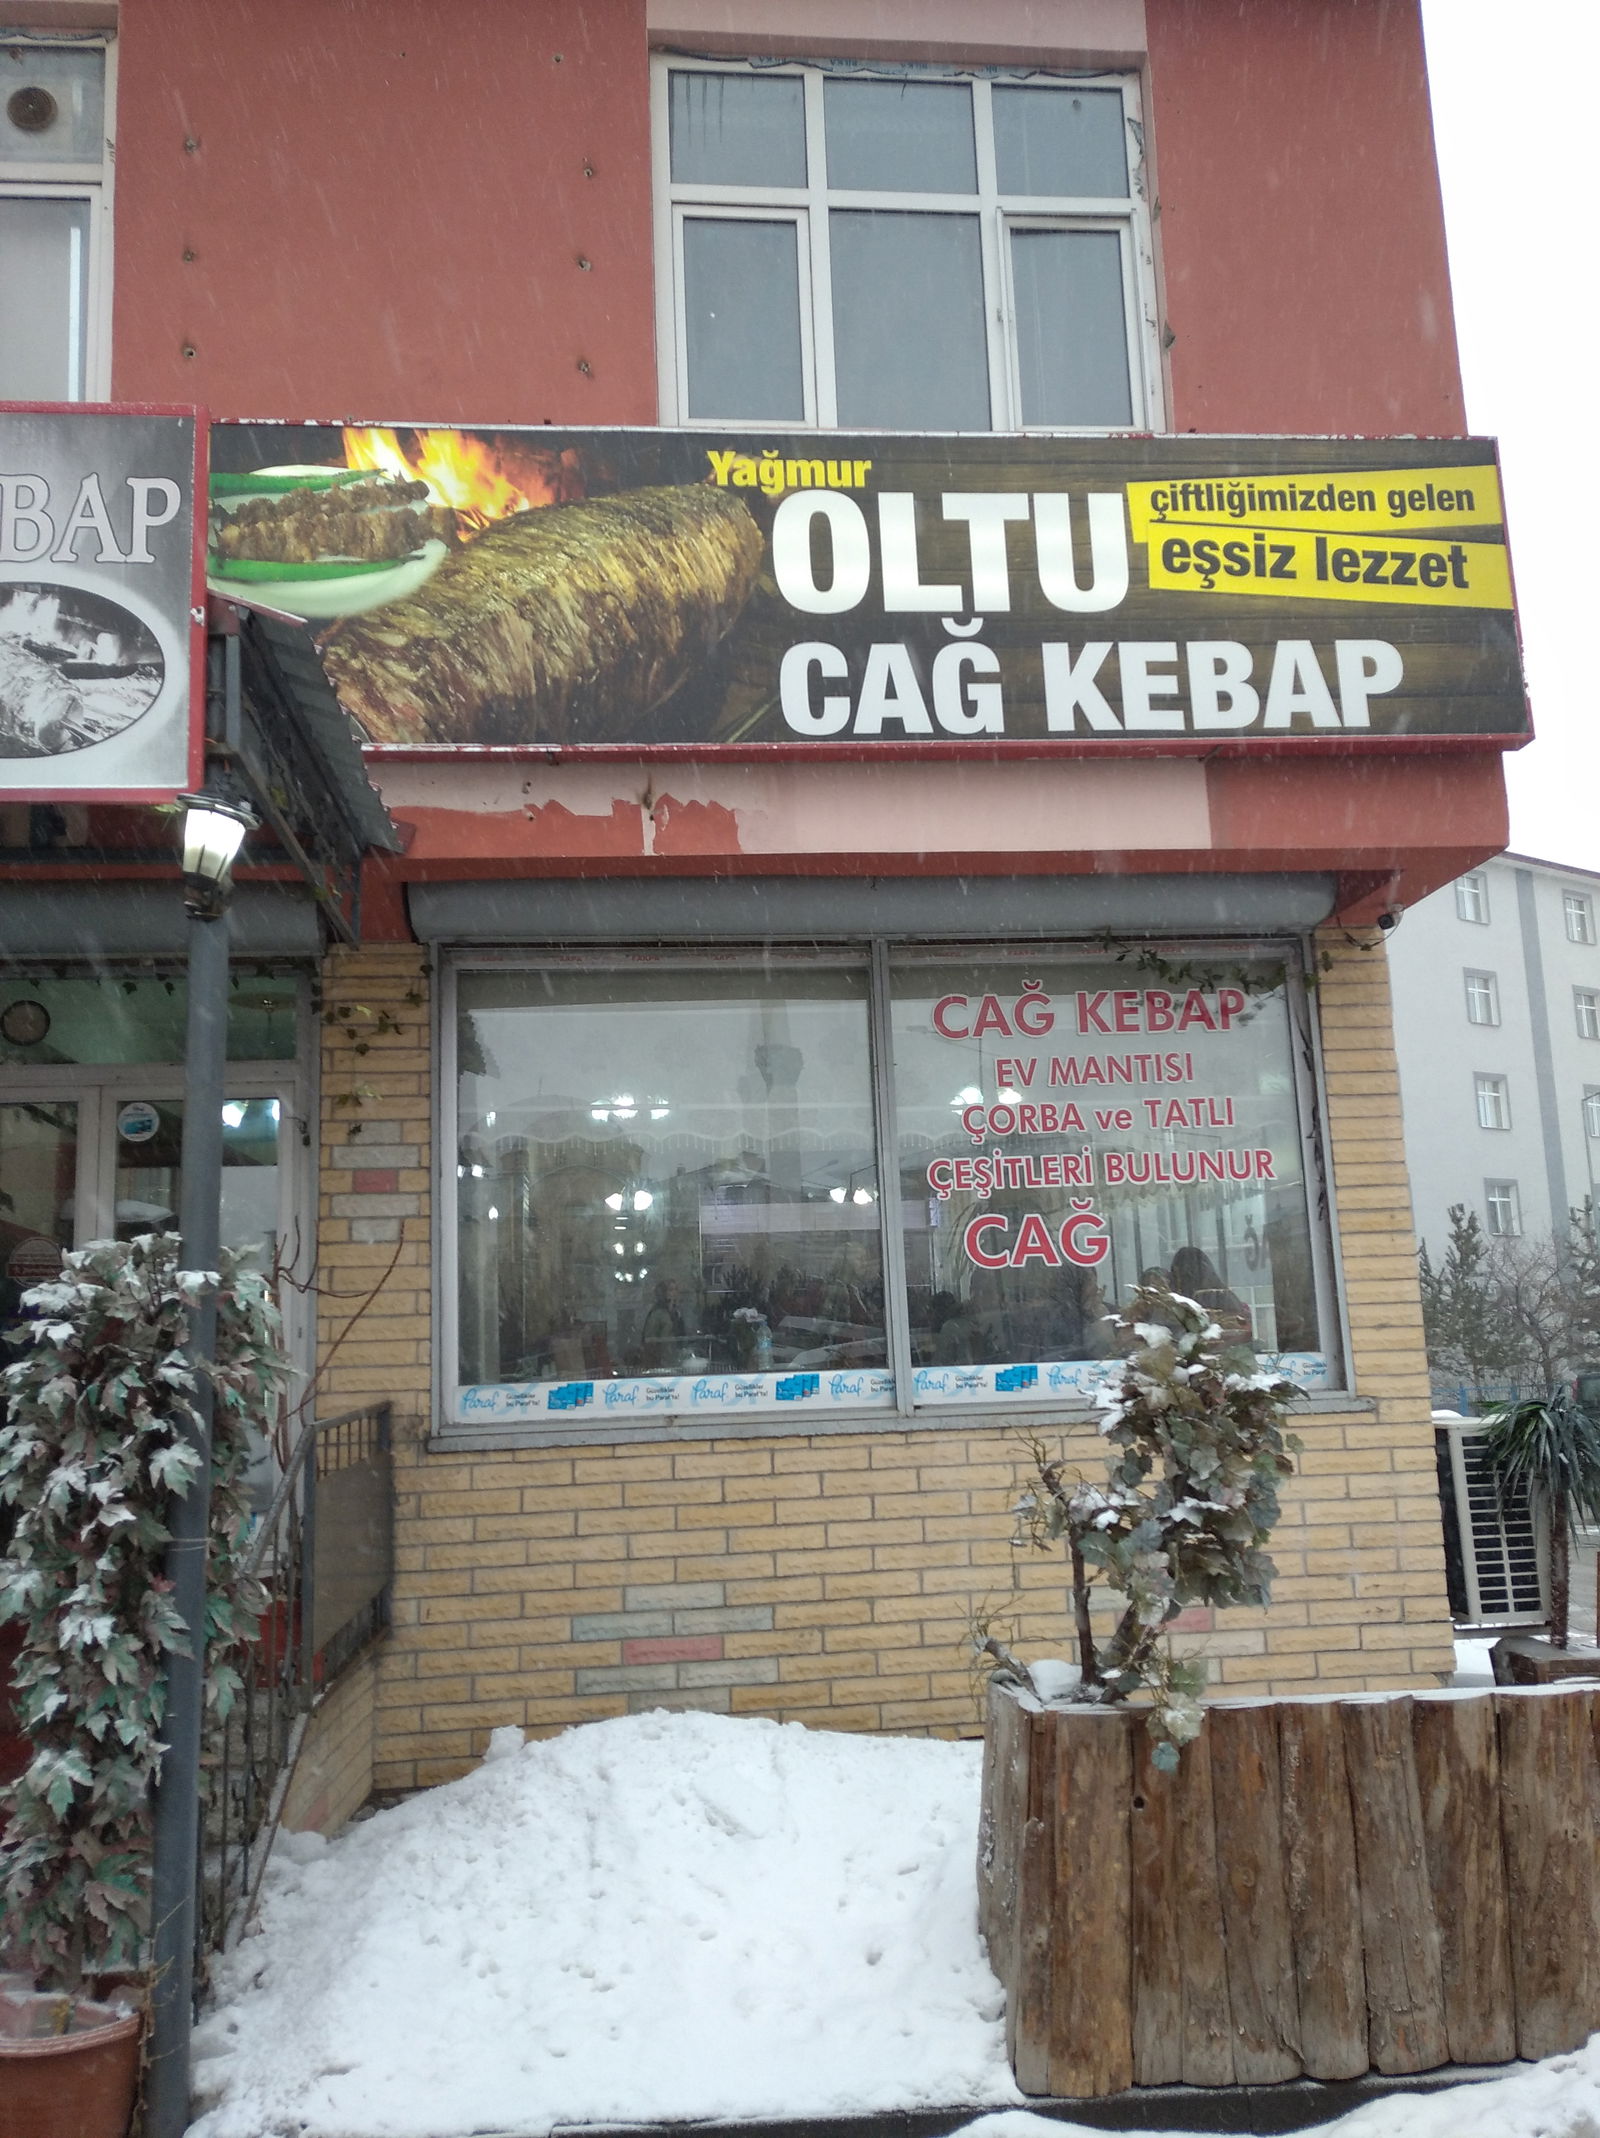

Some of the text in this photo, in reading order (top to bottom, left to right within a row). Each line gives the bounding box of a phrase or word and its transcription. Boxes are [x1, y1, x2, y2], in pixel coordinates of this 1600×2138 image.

[706, 449, 873, 495] Yağmur
[1150, 481, 1476, 520] çiftliğimizden gelen
[772, 489, 1130, 615] OLTU
[1161, 532, 1469, 589] eşsiz lezzet
[779, 617, 1405, 736] CAĞ KEBAP
[932, 980, 1246, 1040] CAĞ KEBAP
[995, 1052, 1195, 1089] EV MANTISI
[961, 1097, 1235, 1144] ÇORBA ve TATLI
[927, 1145, 1278, 1199] ÇEŞİTLERİ BULUNUR
[964, 1197, 1109, 1268] CAĞ
[602, 1382, 639, 1408] Paraf
[692, 1379, 728, 1402] Paraf
[828, 1374, 864, 1396] Paraf
[913, 1370, 949, 1392] Paraf
